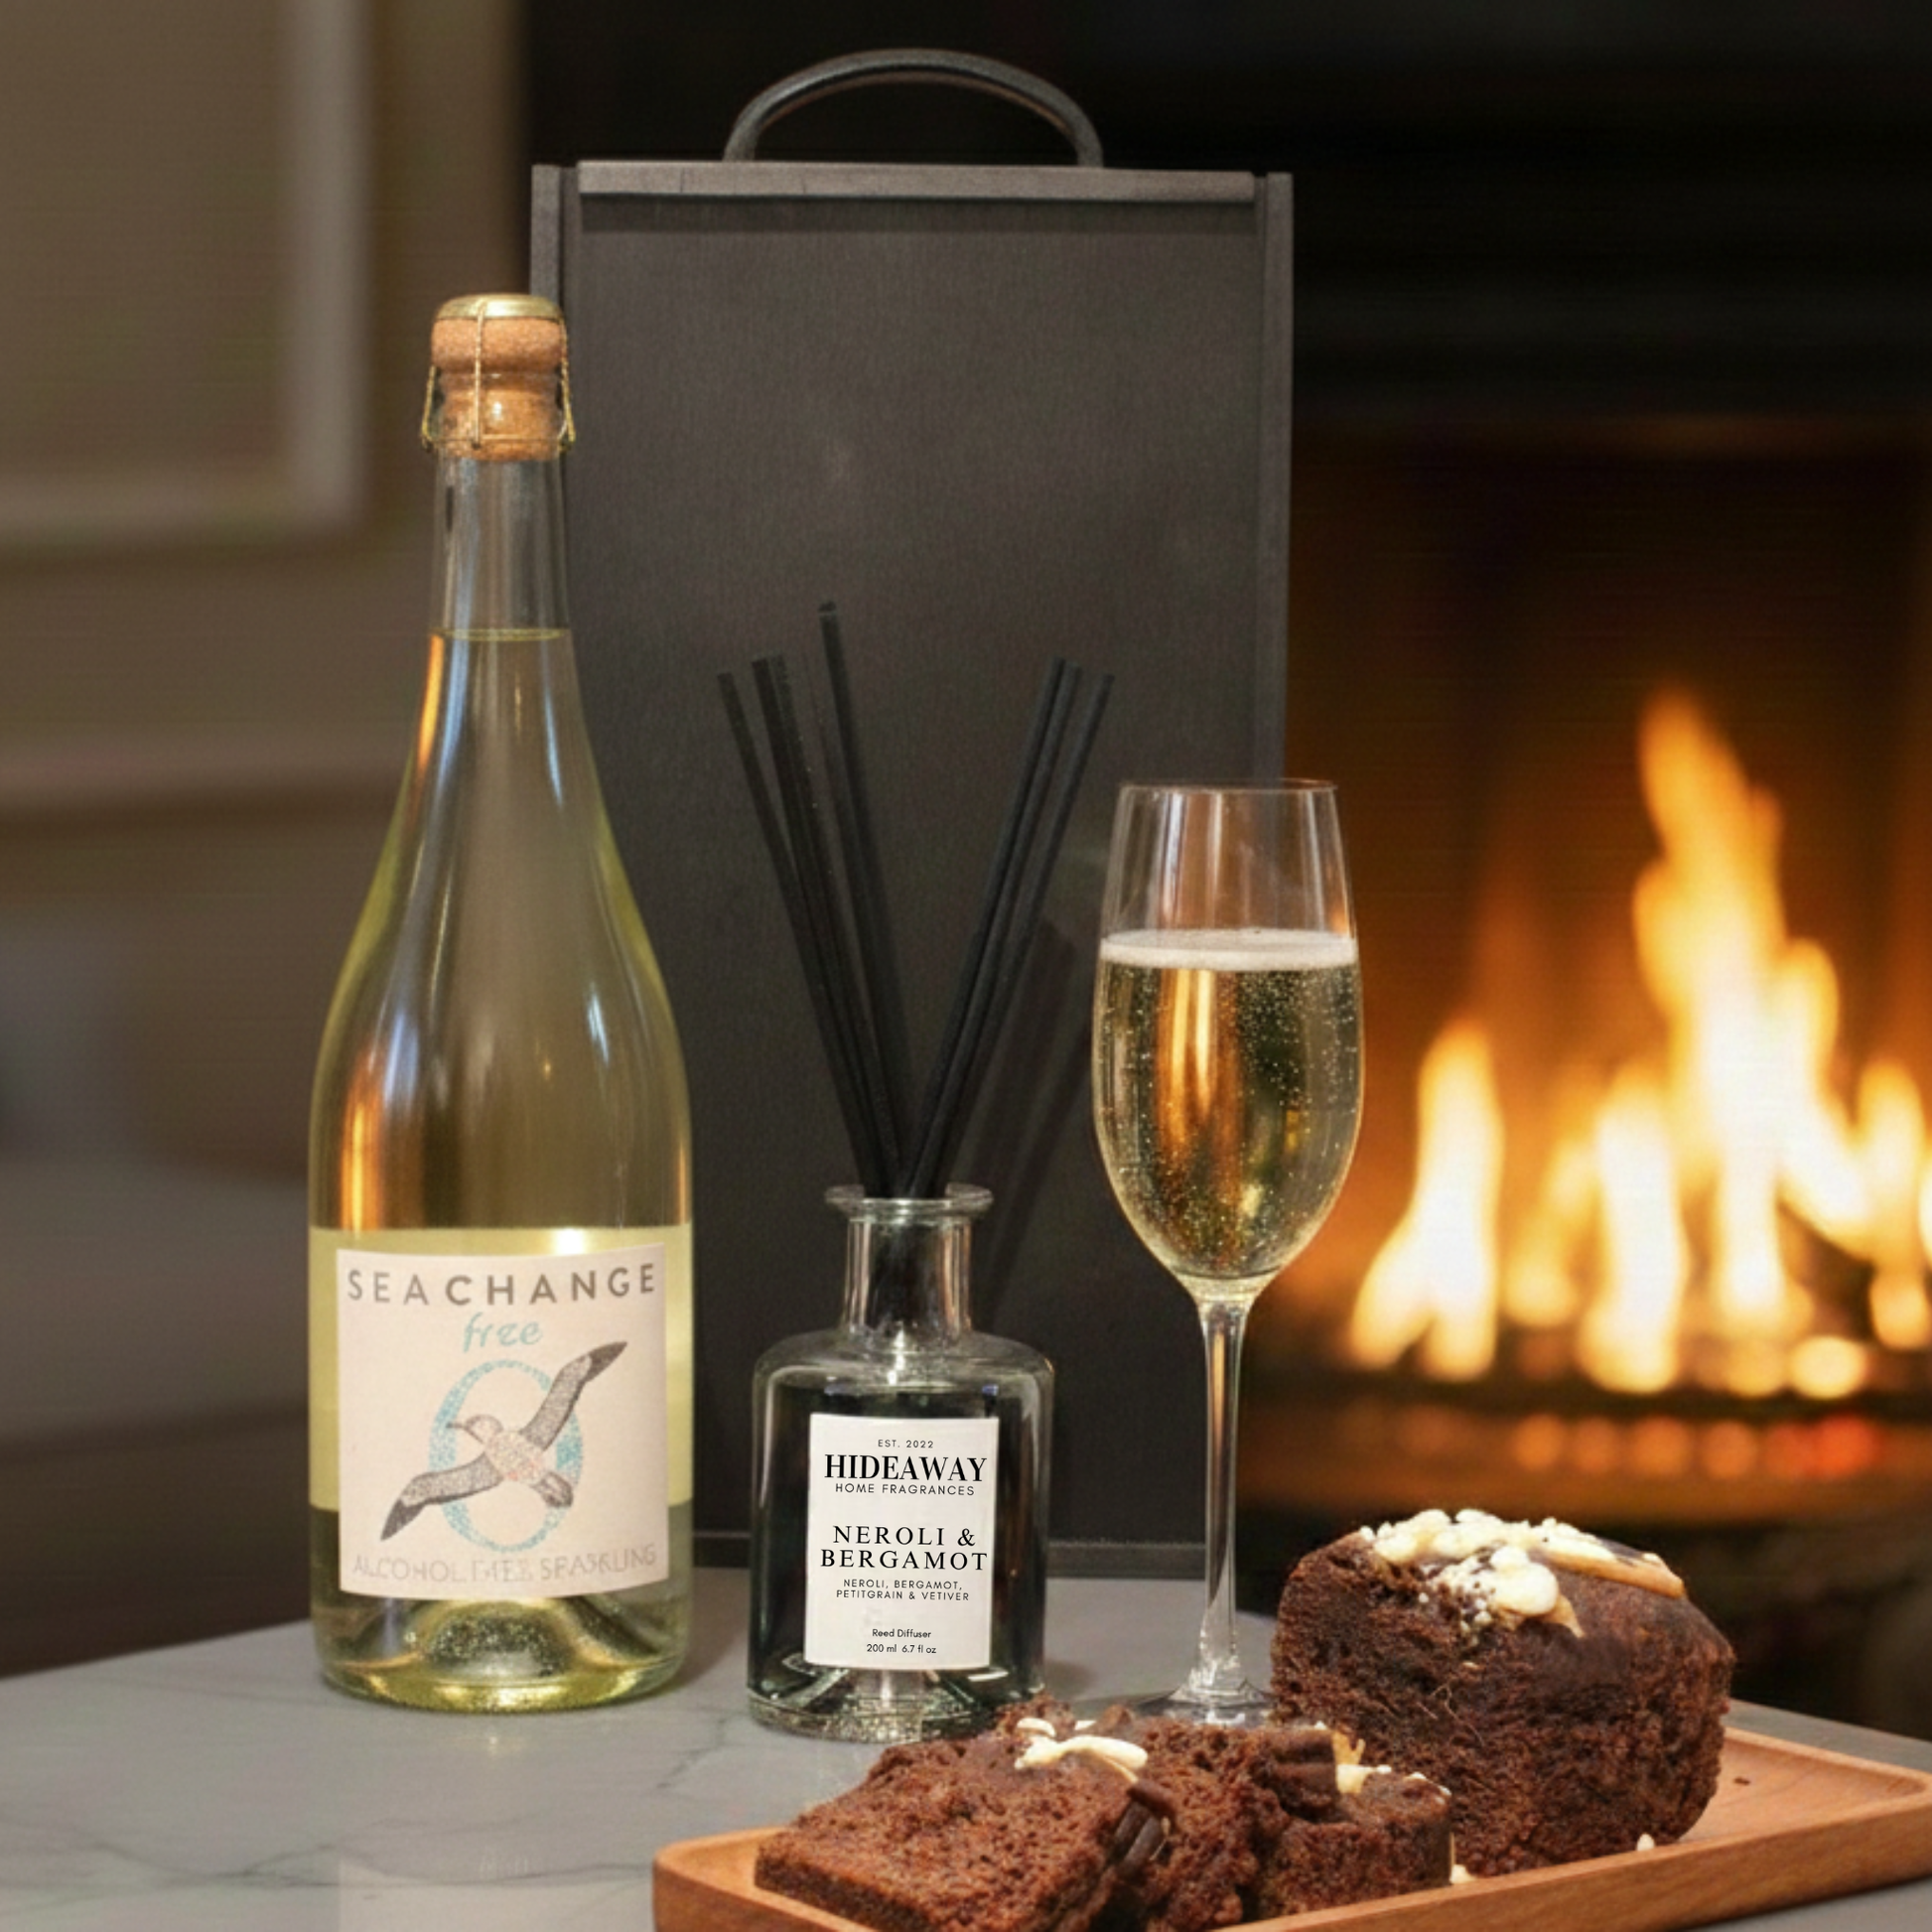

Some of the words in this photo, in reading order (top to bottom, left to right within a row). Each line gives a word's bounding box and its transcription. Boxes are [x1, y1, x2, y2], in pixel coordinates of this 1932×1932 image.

[462, 1311, 544, 1354] free
[877, 1439, 900, 1449] EST.
[905, 1440, 934, 1449] 2022
[824, 1453, 988, 1482] HIDEAWAY
[835, 1482, 876, 1494] HOME
[882, 1483, 976, 1496] FRAGRANCES
[832, 1525, 945, 1546] NEROLI
[956, 1528, 976, 1547] &
[820, 1549, 988, 1572] BERGAMOT
[843, 1579, 890, 1589] NEROLI,
[893, 1580, 963, 1591] BERGAMOT,
[836, 1589, 903, 1600] PETITGRAIN
[908, 1590, 915, 1600] &
[920, 1591, 970, 1601] VETIVER
[872, 1628, 896, 1638] Reed
[897, 1628, 932, 1639] Diffuser
[866, 1643, 885, 1653] 200
[886, 1643, 897, 1653] ml
[900, 1644, 915, 1654] 6.7
[916, 1644, 924, 1654] fl
